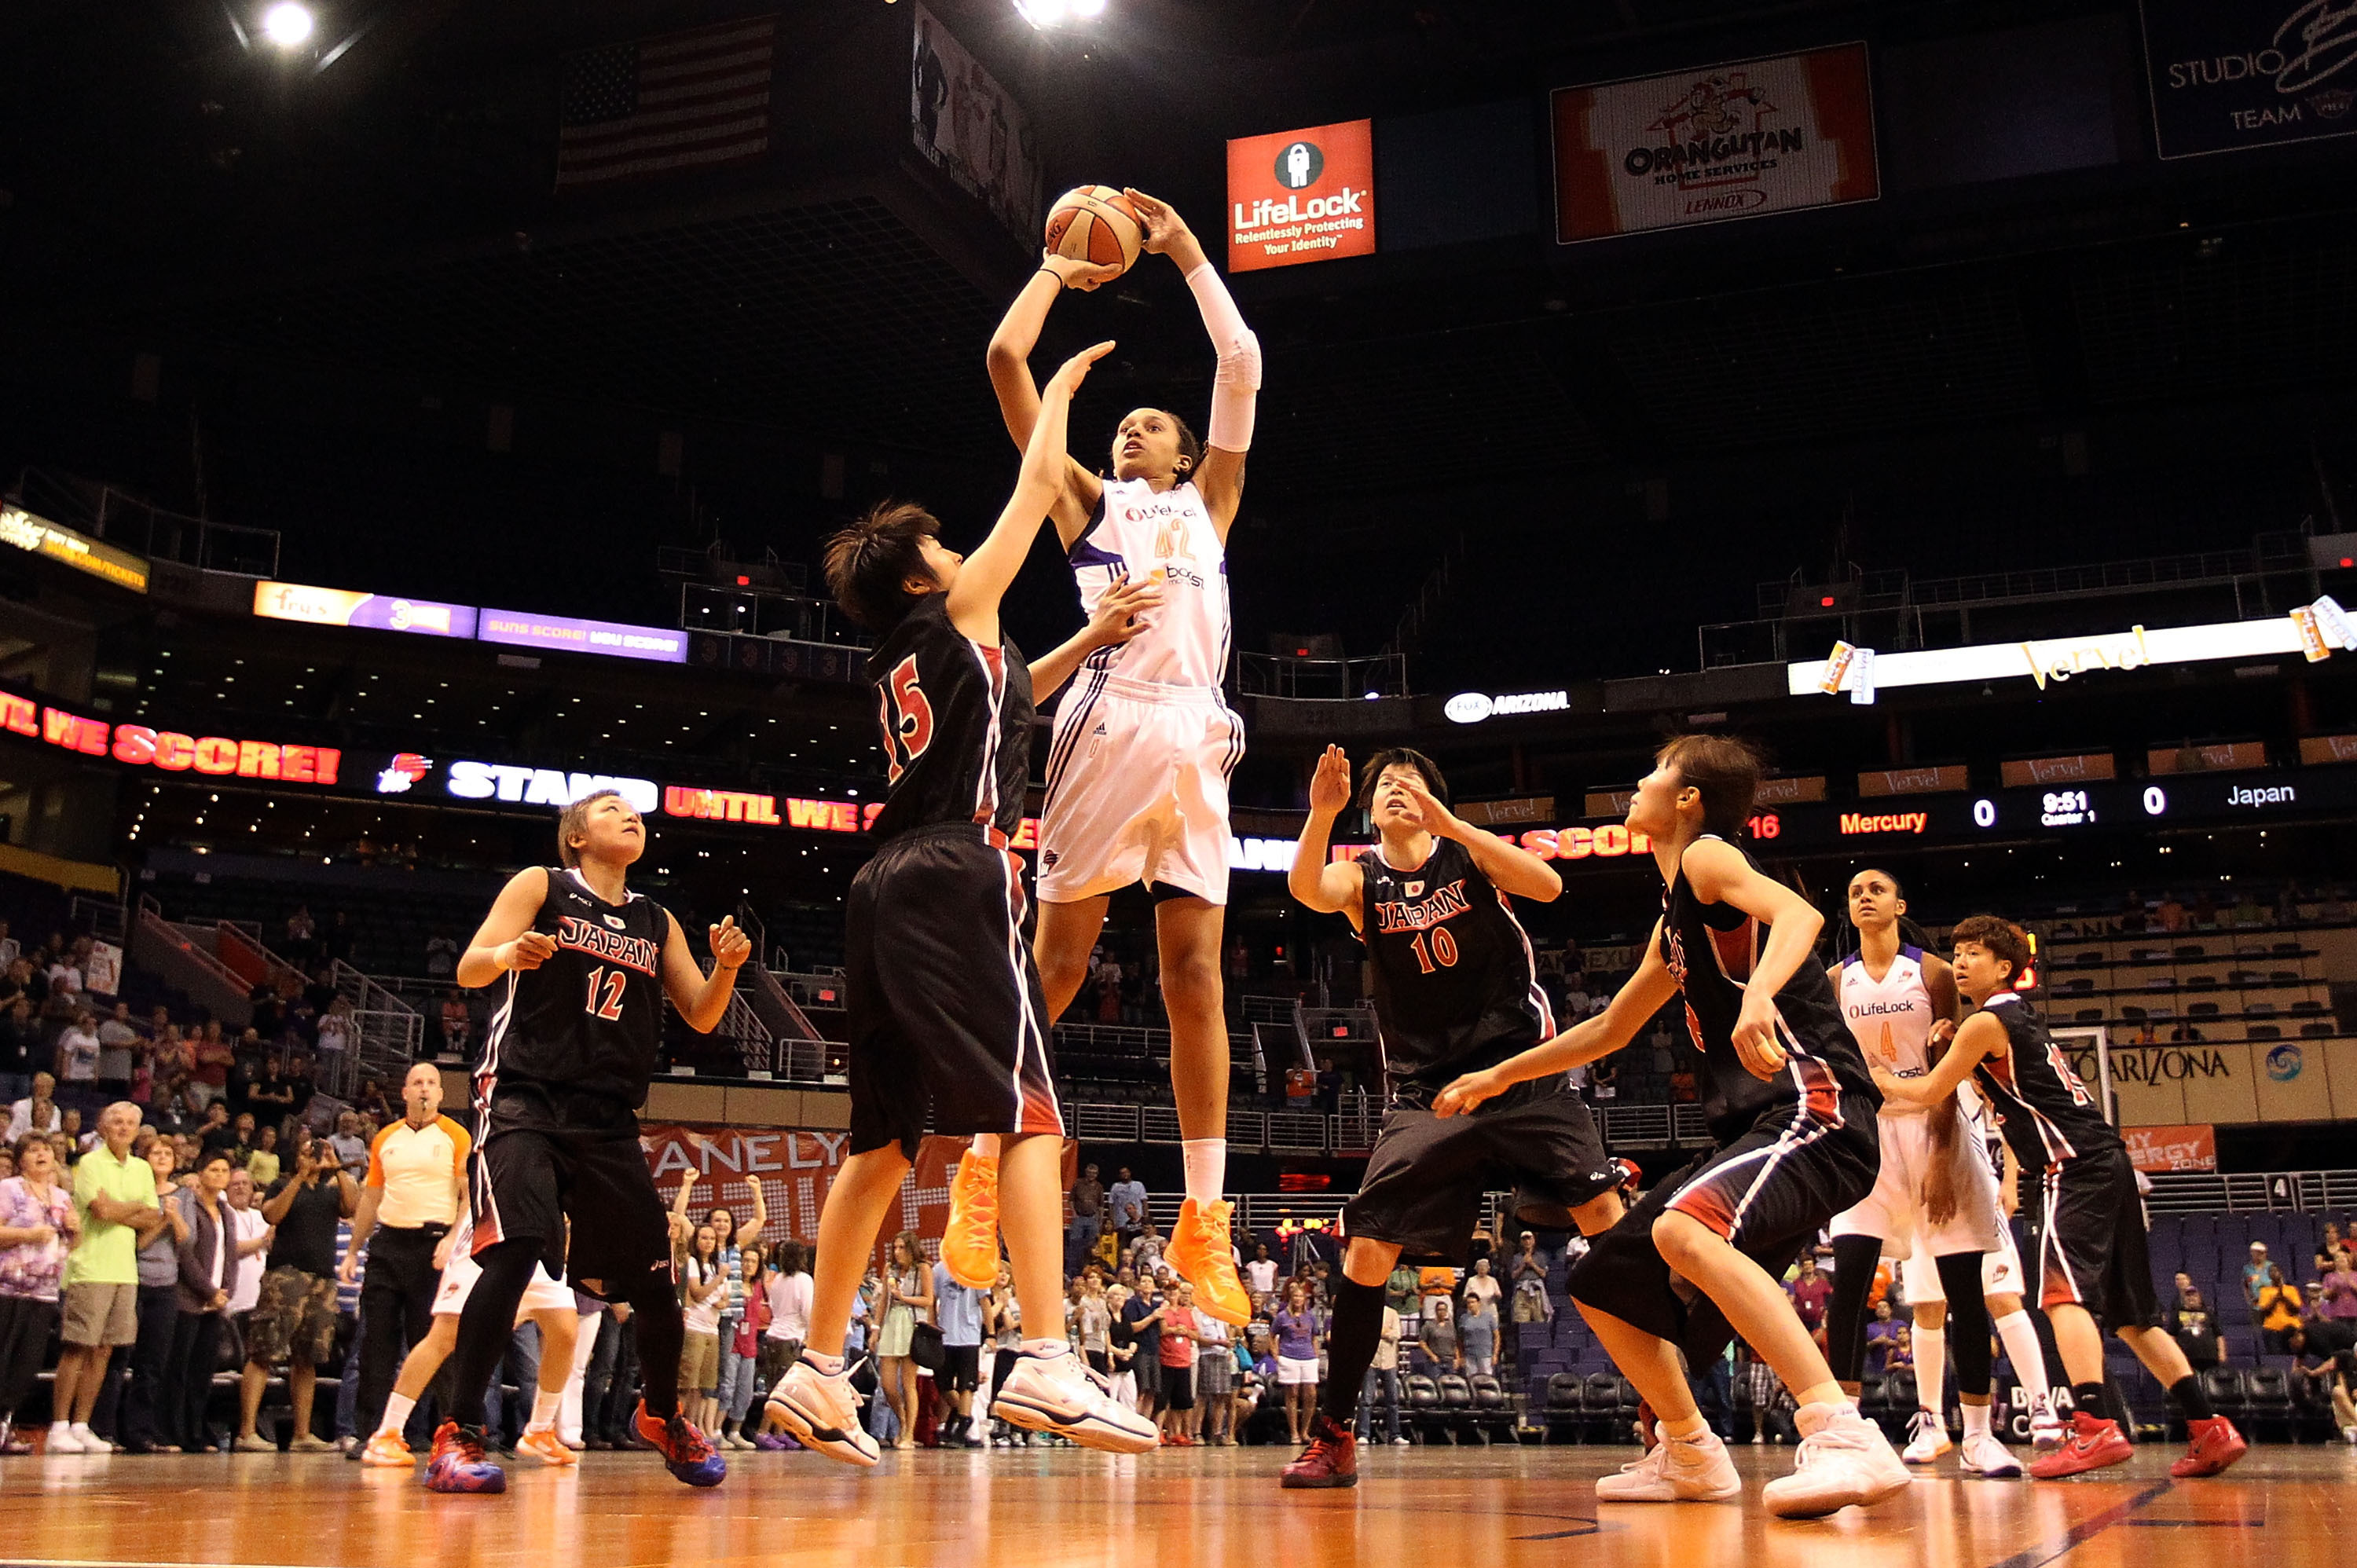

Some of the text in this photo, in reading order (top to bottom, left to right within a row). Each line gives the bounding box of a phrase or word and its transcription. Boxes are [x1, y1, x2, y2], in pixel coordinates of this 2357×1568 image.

[2169, 49, 2285, 88] STUDIO
[2230, 104, 2301, 130] TEAM
[1626, 127, 1802, 176] ORANGUTAN
[1655, 159, 1778, 185] HOME SERVICES
[1234, 187, 1362, 230] LifeLock
[1684, 193, 1744, 215] LENNOX
[1235, 217, 1364, 244] Relentlessly Protecting
[1264, 243, 1289, 255] Your
[1155, 518, 1197, 561] 42
[2022, 625, 2151, 691] Verve!
[43, 706, 110, 756] WE
[112, 724, 341, 784] SCORE!
[449, 760, 658, 814] STAND
[665, 785, 782, 826] UNTIL
[786, 797, 858, 833] WE
[1758, 779, 1799, 801] erve!
[2044, 790, 2087, 813] 9:51
[2143, 786, 2166, 815] 0
[2227, 786, 2294, 808] Japan
[1747, 814, 1780, 839] 16
[1840, 811, 1927, 834] Mercury
[1974, 798, 1996, 827] 0
[2088, 809, 2096, 823] 1
[1375, 878, 1472, 934] JAPAN
[558, 915, 659, 978] JAPAN
[1410, 926, 1458, 974] 10
[585, 965, 626, 1021] 12
[1860, 999, 1915, 1017] LifeLock
[1880, 1021, 1897, 1062] 4
[2109, 1047, 2230, 1086] ARIZONA
[653, 1132, 848, 1178] ANELY
[2011, 1386, 2075, 1409] BVA
